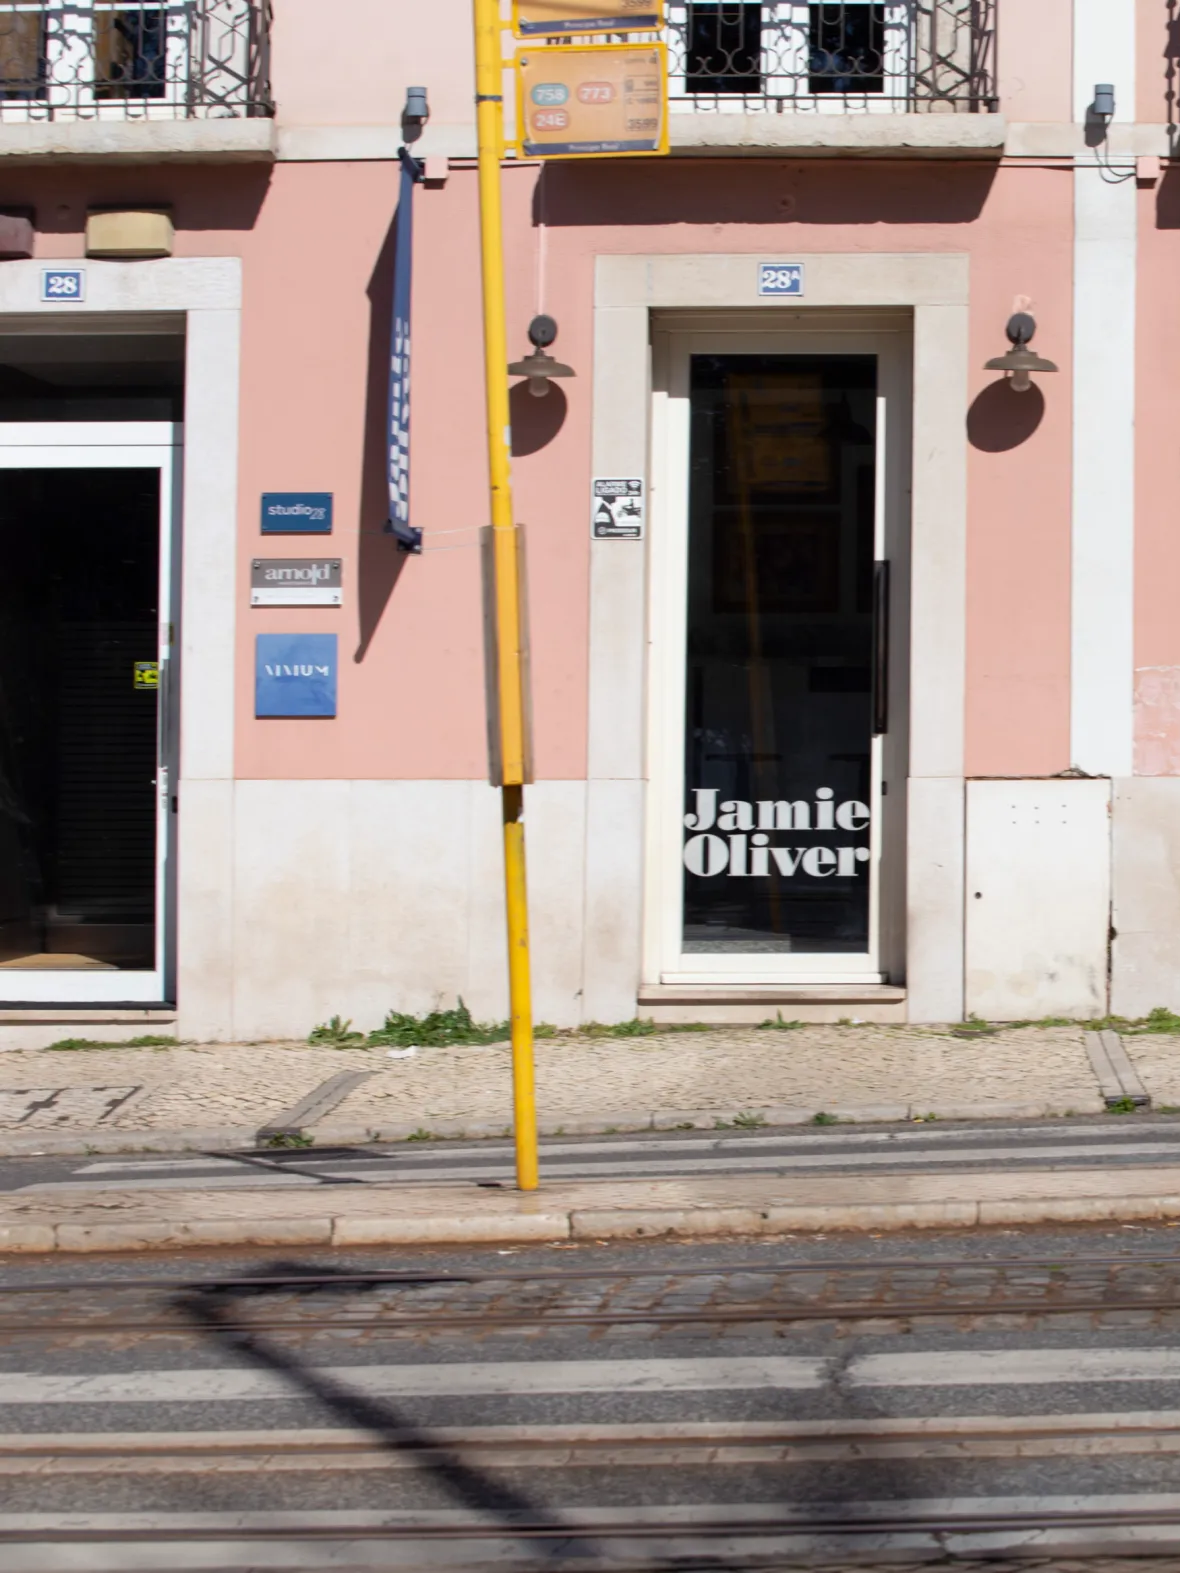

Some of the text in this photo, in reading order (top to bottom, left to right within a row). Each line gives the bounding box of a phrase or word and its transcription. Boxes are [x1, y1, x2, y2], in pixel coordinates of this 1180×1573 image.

[536, 88, 565, 101] 758
[581, 87, 611, 100] 773
[535, 113, 566, 127] 24E
[48, 276, 78, 294] 28
[683, 787, 871, 831] Jamie
[683, 833, 871, 877] Oliver
